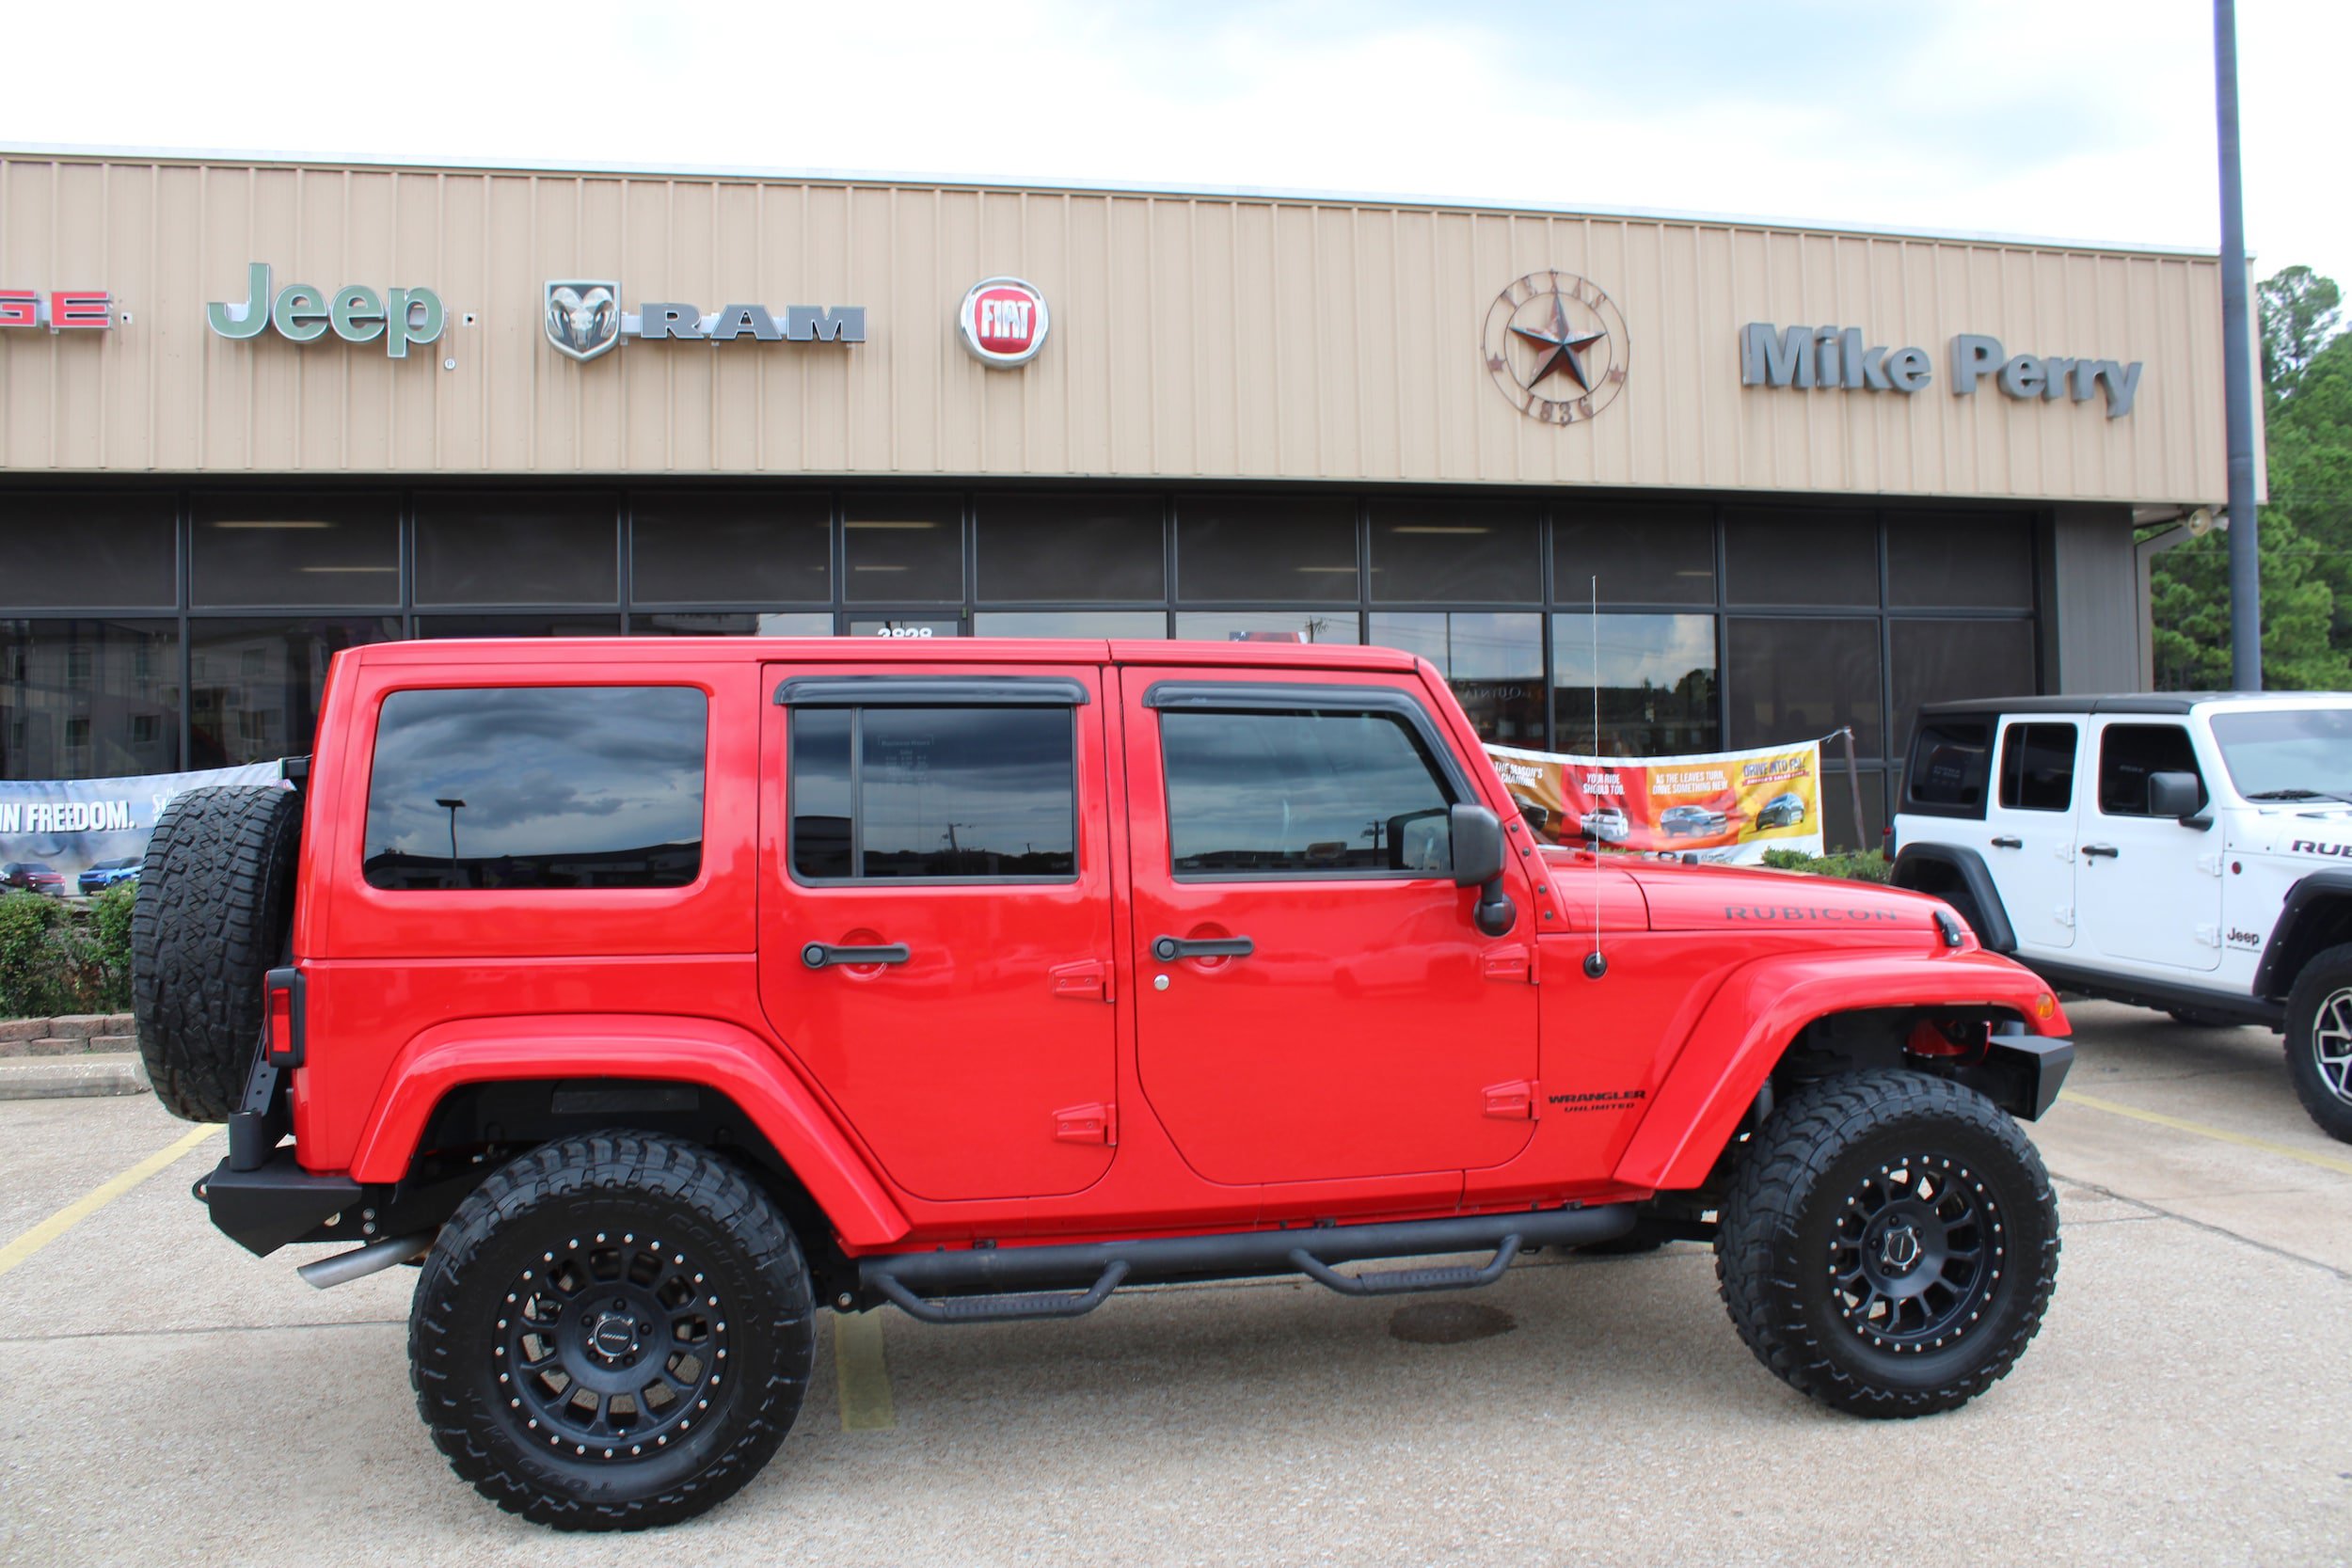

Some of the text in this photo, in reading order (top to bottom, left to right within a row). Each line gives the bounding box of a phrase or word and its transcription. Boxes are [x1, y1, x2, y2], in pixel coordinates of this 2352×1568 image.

[207, 262, 446, 358] Jeep
[640, 302, 867, 343] RAM
[980, 298, 1033, 340] FIAT
[1740, 323, 2143, 420] Mike Perry
[1521, 394, 1595, 426] 1836
[1494, 761, 1509, 773] THE
[1743, 762, 1768, 777] DRIVE
[1604, 773, 1621, 784] RIDE
[1656, 773, 1664, 784] AS
[1666, 772, 1679, 784] THE
[1680, 770, 1705, 783] LEAVES
[1582, 783, 1610, 795] SHOULD
[1652, 784, 1671, 795] DRIVE
[1672, 782, 1710, 794] SOMETHING
[26, 800, 137, 832] FREEDOM.
[1724, 906, 1899, 921] RUBICON
[2227, 927, 2260, 946] Jeep
[1549, 1089, 1645, 1104] WRANGLER
[1564, 1102, 1635, 1113] UNLIMITED
